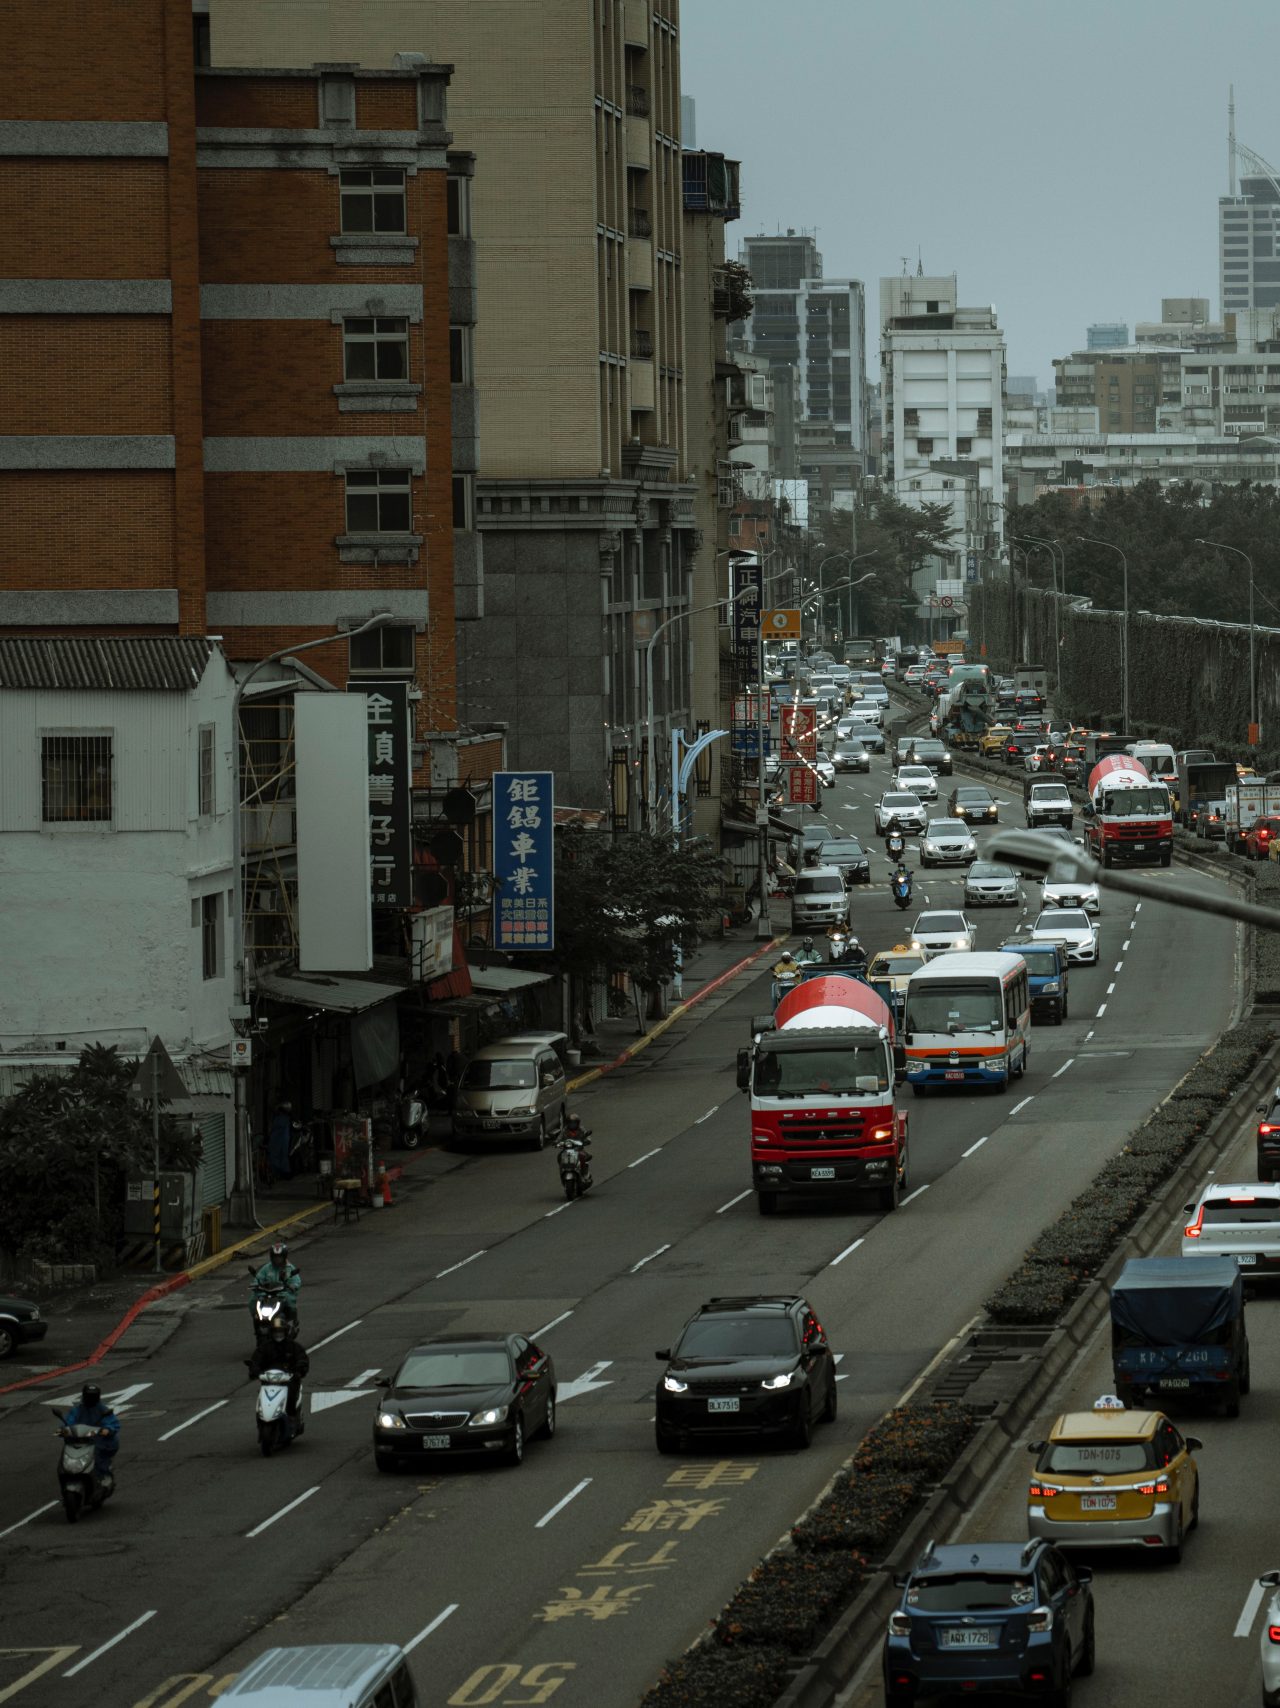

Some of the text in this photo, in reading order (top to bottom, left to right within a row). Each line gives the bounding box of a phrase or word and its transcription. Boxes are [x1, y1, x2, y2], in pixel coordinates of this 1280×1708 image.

[371, 893, 397, 903] 河店
[1078, 1449, 1121, 1460] TDN-1075
[446, 1661, 577, 1707] 50
